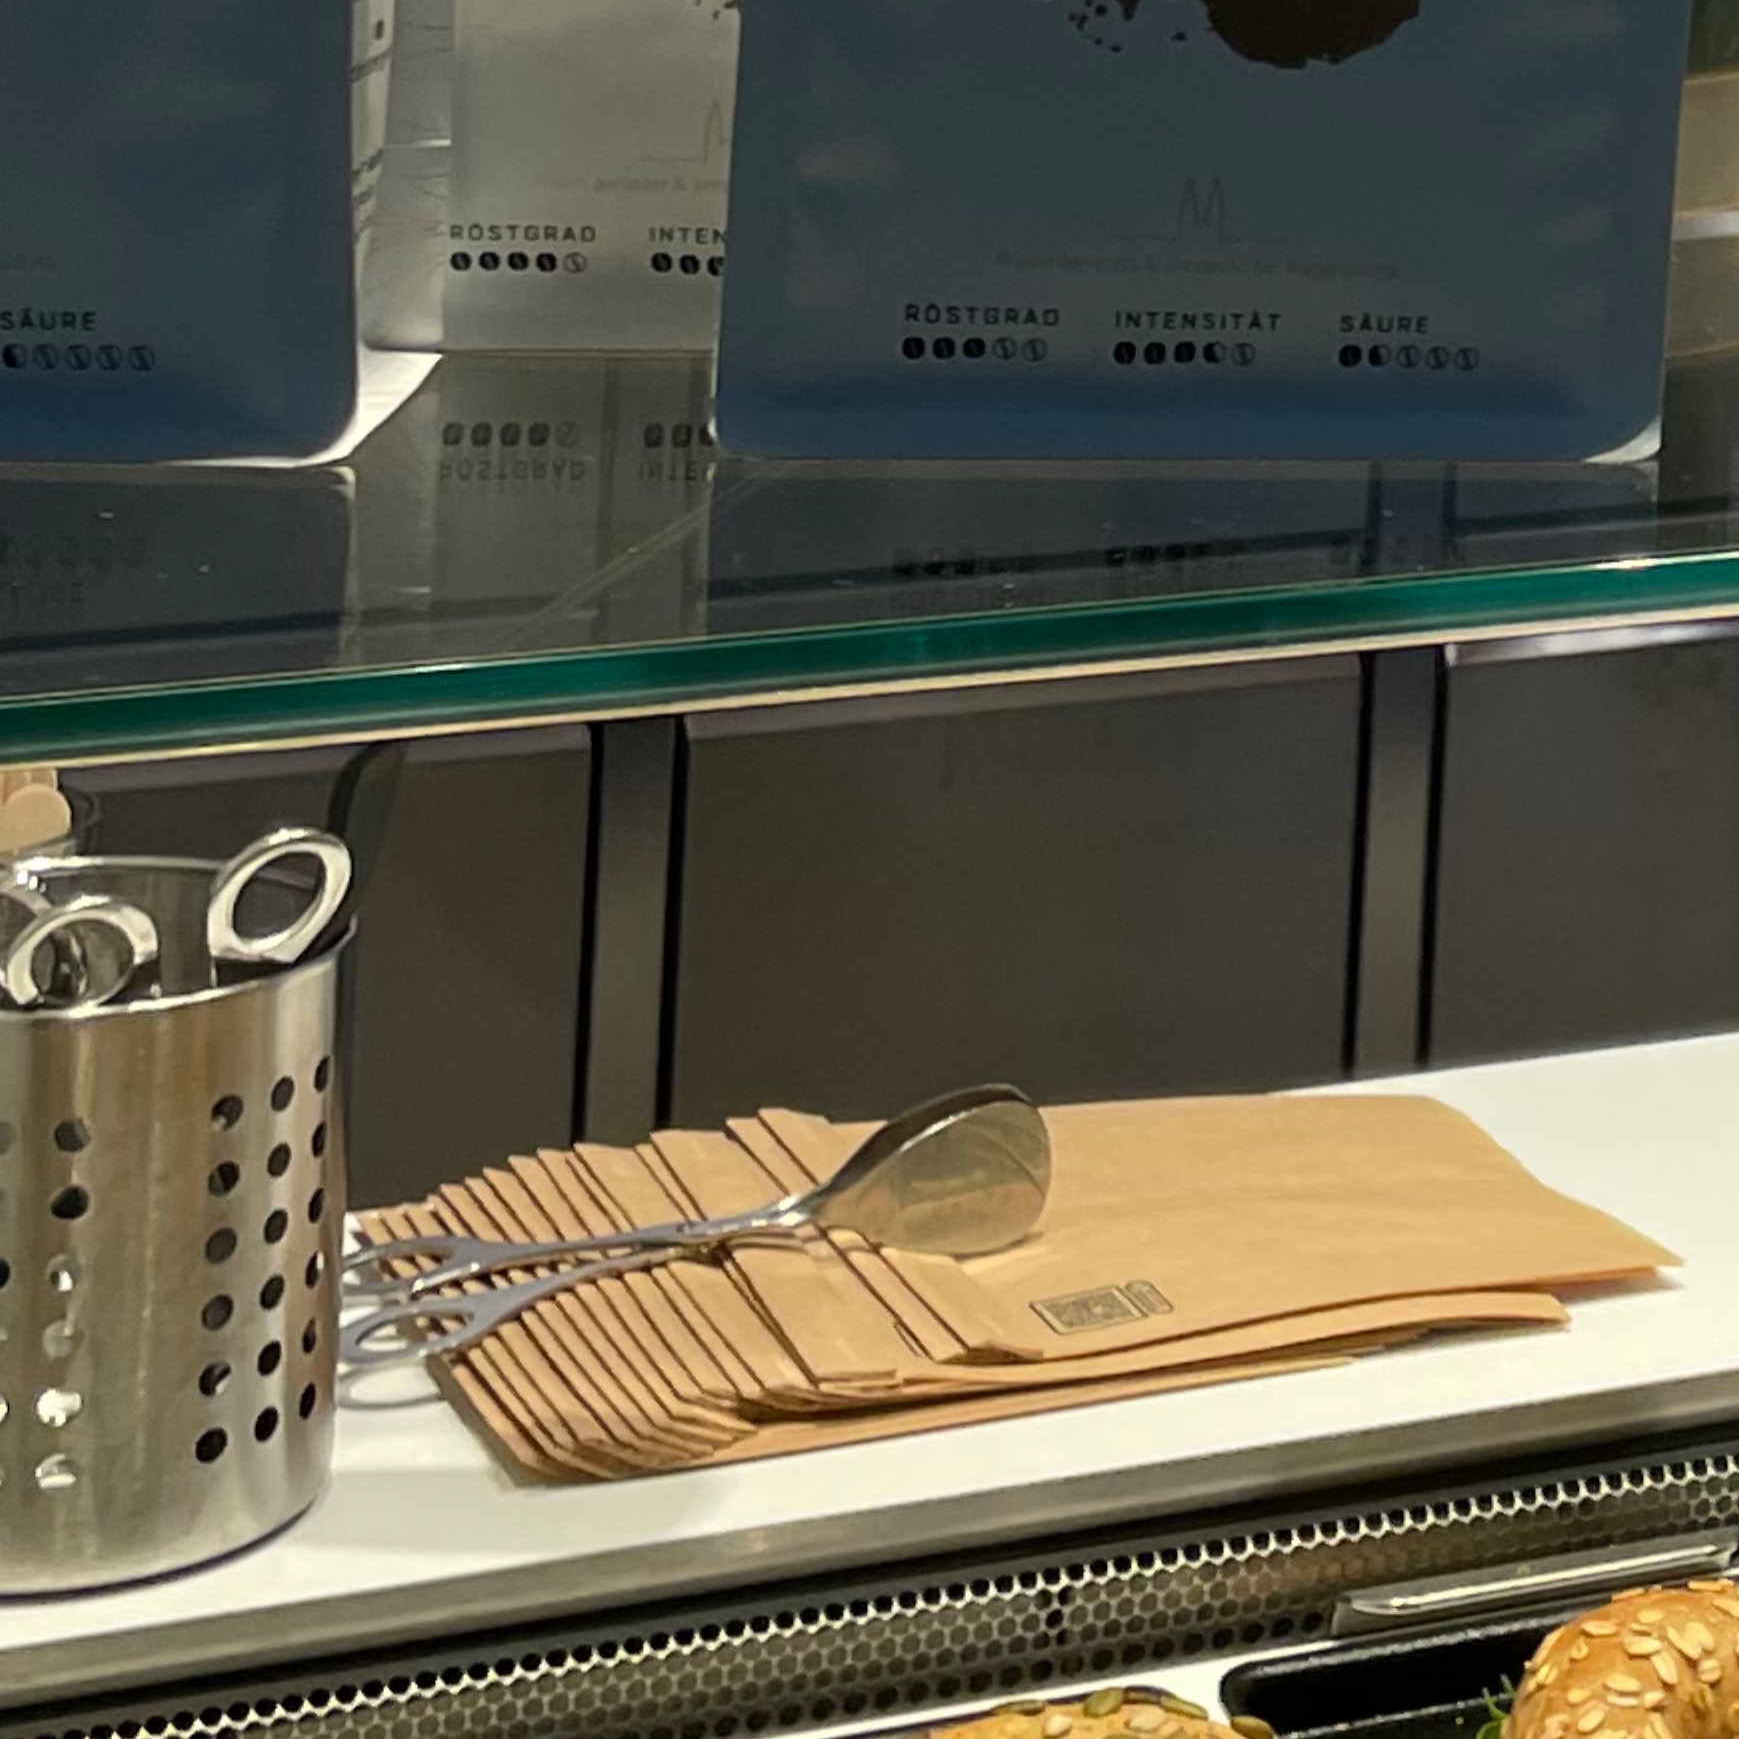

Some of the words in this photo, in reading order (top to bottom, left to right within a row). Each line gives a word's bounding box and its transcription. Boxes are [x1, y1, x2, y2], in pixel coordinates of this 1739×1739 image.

[450, 223, 596, 242] RÖSTGRAD
[0, 308, 97, 331] SÄURE
[904, 303, 1060, 327] RÖSTGRAD
[1114, 308, 1282, 332] INTENSITÄT
[1340, 311, 1430, 336] SÄURE
